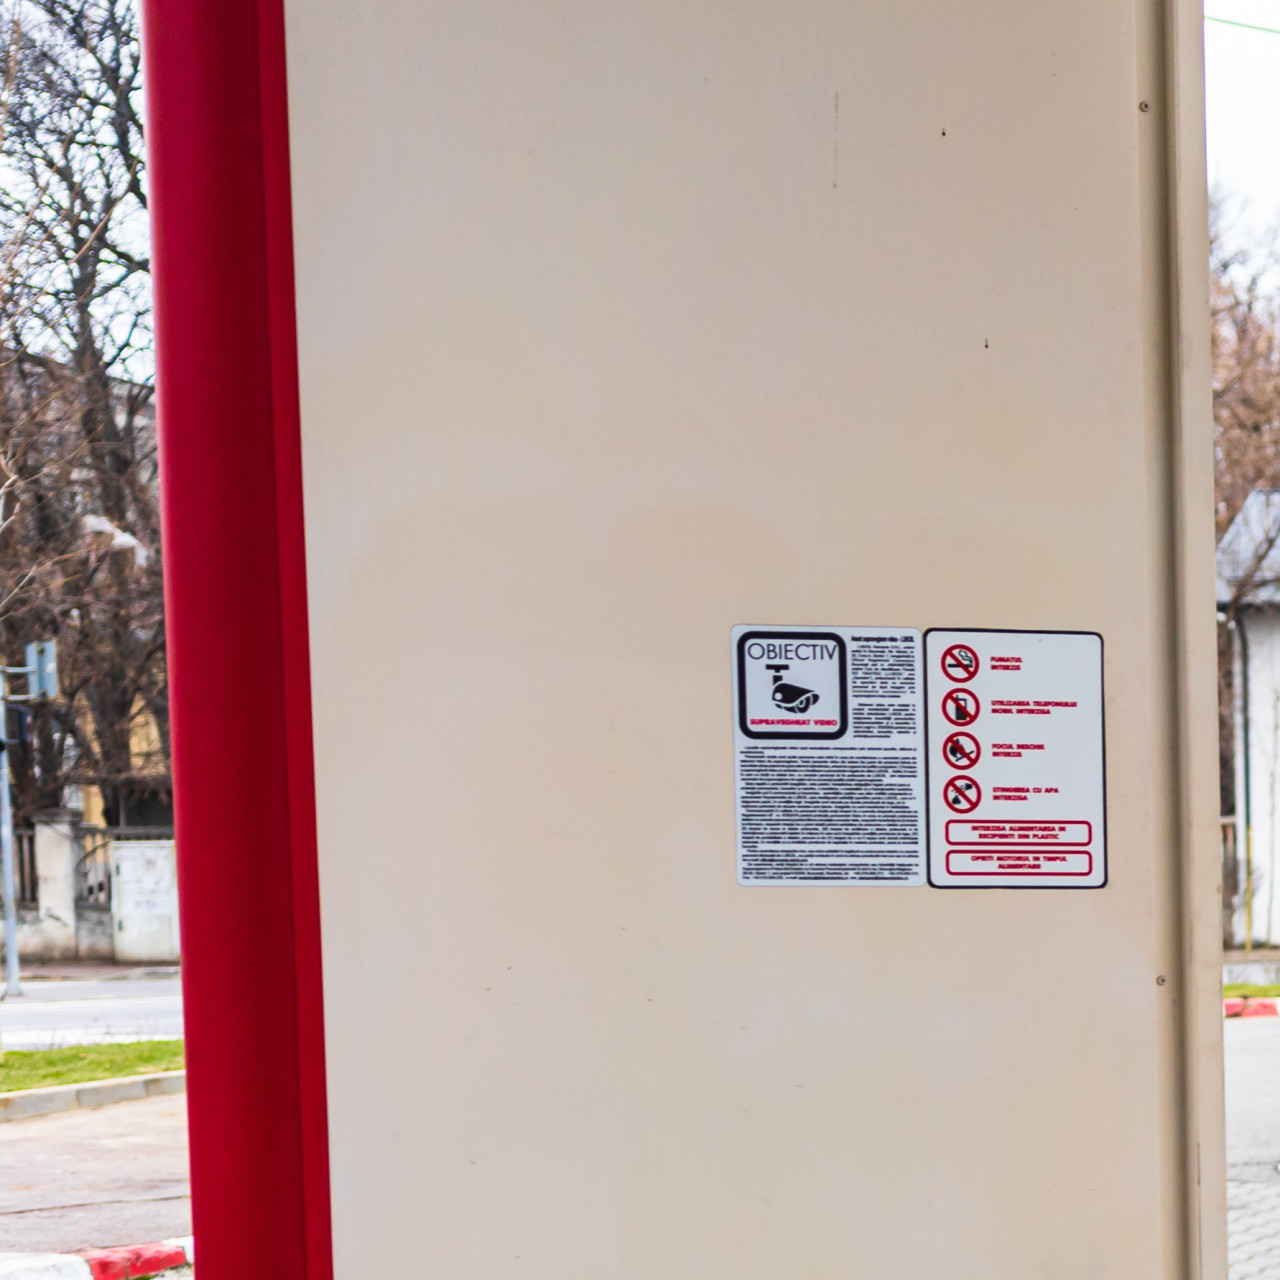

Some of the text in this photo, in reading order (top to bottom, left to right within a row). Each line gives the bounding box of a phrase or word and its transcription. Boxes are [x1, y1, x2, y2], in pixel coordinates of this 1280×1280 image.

[747, 642, 837, 661] OBIECTIV
[749, 717, 838, 727] SUPRAVEGHEAT VIDEO
